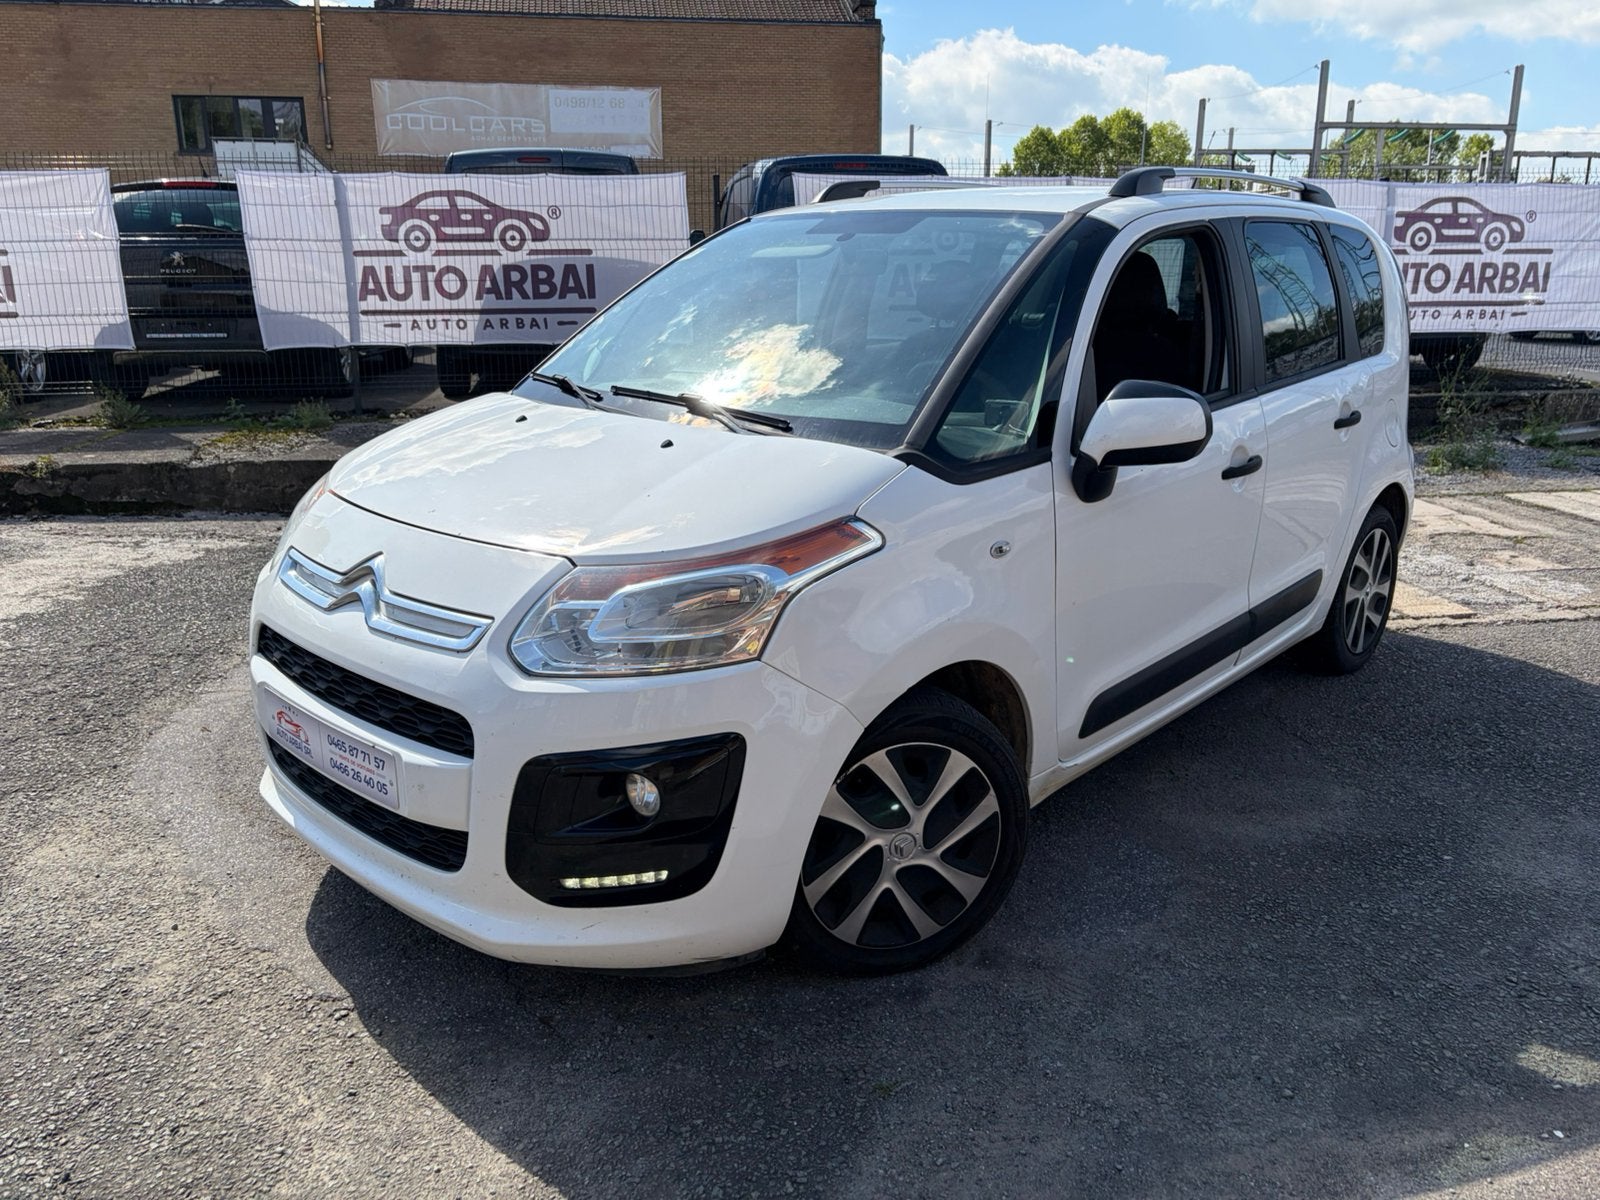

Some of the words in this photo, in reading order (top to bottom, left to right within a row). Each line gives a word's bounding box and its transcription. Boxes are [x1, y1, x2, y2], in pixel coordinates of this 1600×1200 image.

[358, 265, 468, 301] AUTO
[475, 263, 597, 301] ARBAI
[1402, 262, 1451, 295] TO
[1452, 261, 1552, 295] ARBAI
[410, 319, 468, 331] AUTO
[482, 317, 548, 331] ARBAI
[1409, 309, 1442, 321] UTO
[1452, 309, 1505, 321] ARBAI
[327, 734, 347, 753] 0465
[348, 744, 359, 759] 87
[360, 750, 371, 766] 71
[374, 756, 386, 771] 57
[330, 757, 350, 777] 0466
[351, 768, 362, 783] 26
[363, 775, 375, 789] 40
[376, 780, 389, 796] 05
